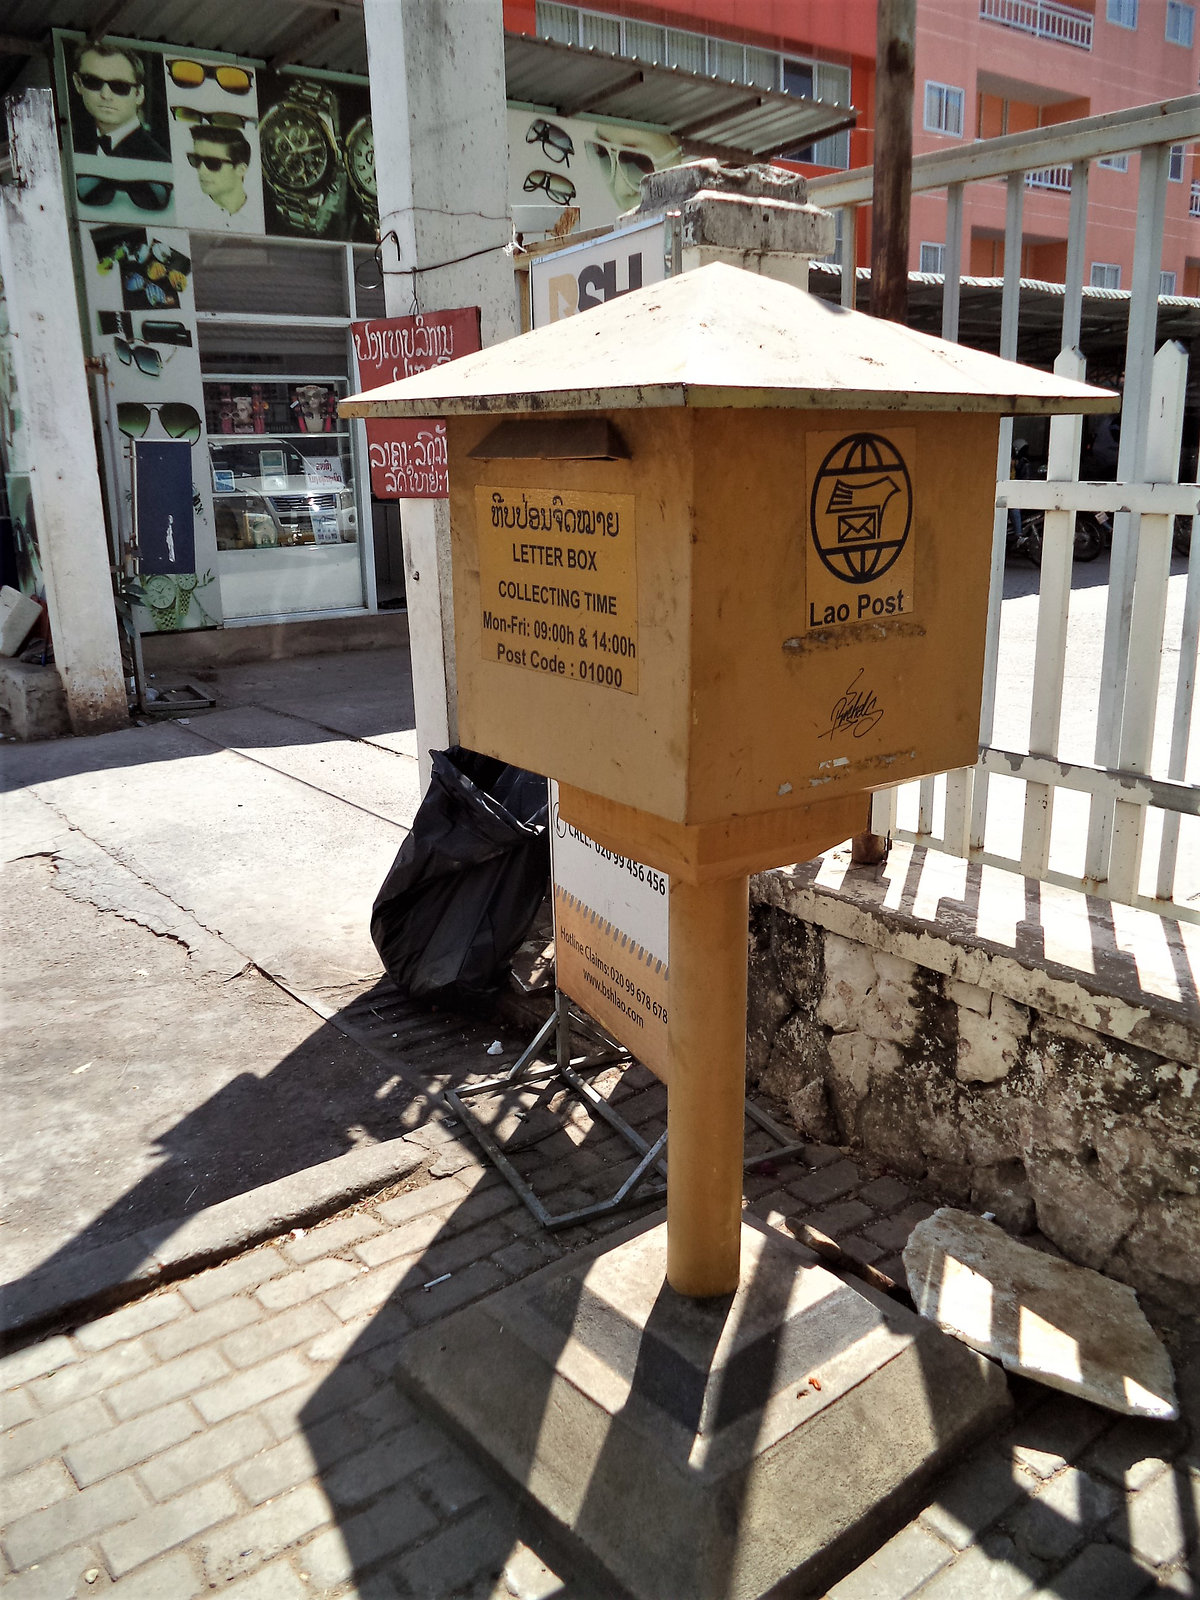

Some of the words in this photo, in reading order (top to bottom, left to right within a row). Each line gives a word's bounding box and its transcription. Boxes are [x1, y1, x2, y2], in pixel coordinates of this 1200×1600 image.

[512, 543, 563, 567] LETTER
[567, 548, 597, 571] BOX
[498, 580, 580, 609] COLLECTING
[584, 592, 617, 616] TIME
[810, 602, 850, 627] Lao
[857, 589, 904, 619] Post
[483, 611, 530, 637] Mon-Fri:
[533, 620, 574, 645] 09:00h
[578, 627, 588, 648] &
[592, 630, 636, 658] 14:00h
[497, 643, 526, 666] Post
[530, 650, 565, 674] Code
[570, 662, 574, 676] :
[579, 660, 623, 688] 01000
[626, 859, 645, 882] 456
[646, 870, 666, 896] 456
[560, 925, 584, 955] Hotline
[584, 945, 610, 977] Claims:
[610, 966, 624, 988] 020
[625, 978, 636, 997] 99
[636, 988, 652, 1011] 678
[652, 1001, 668, 1024] 678
[583, 968, 645, 1029] www.bshlao.com
